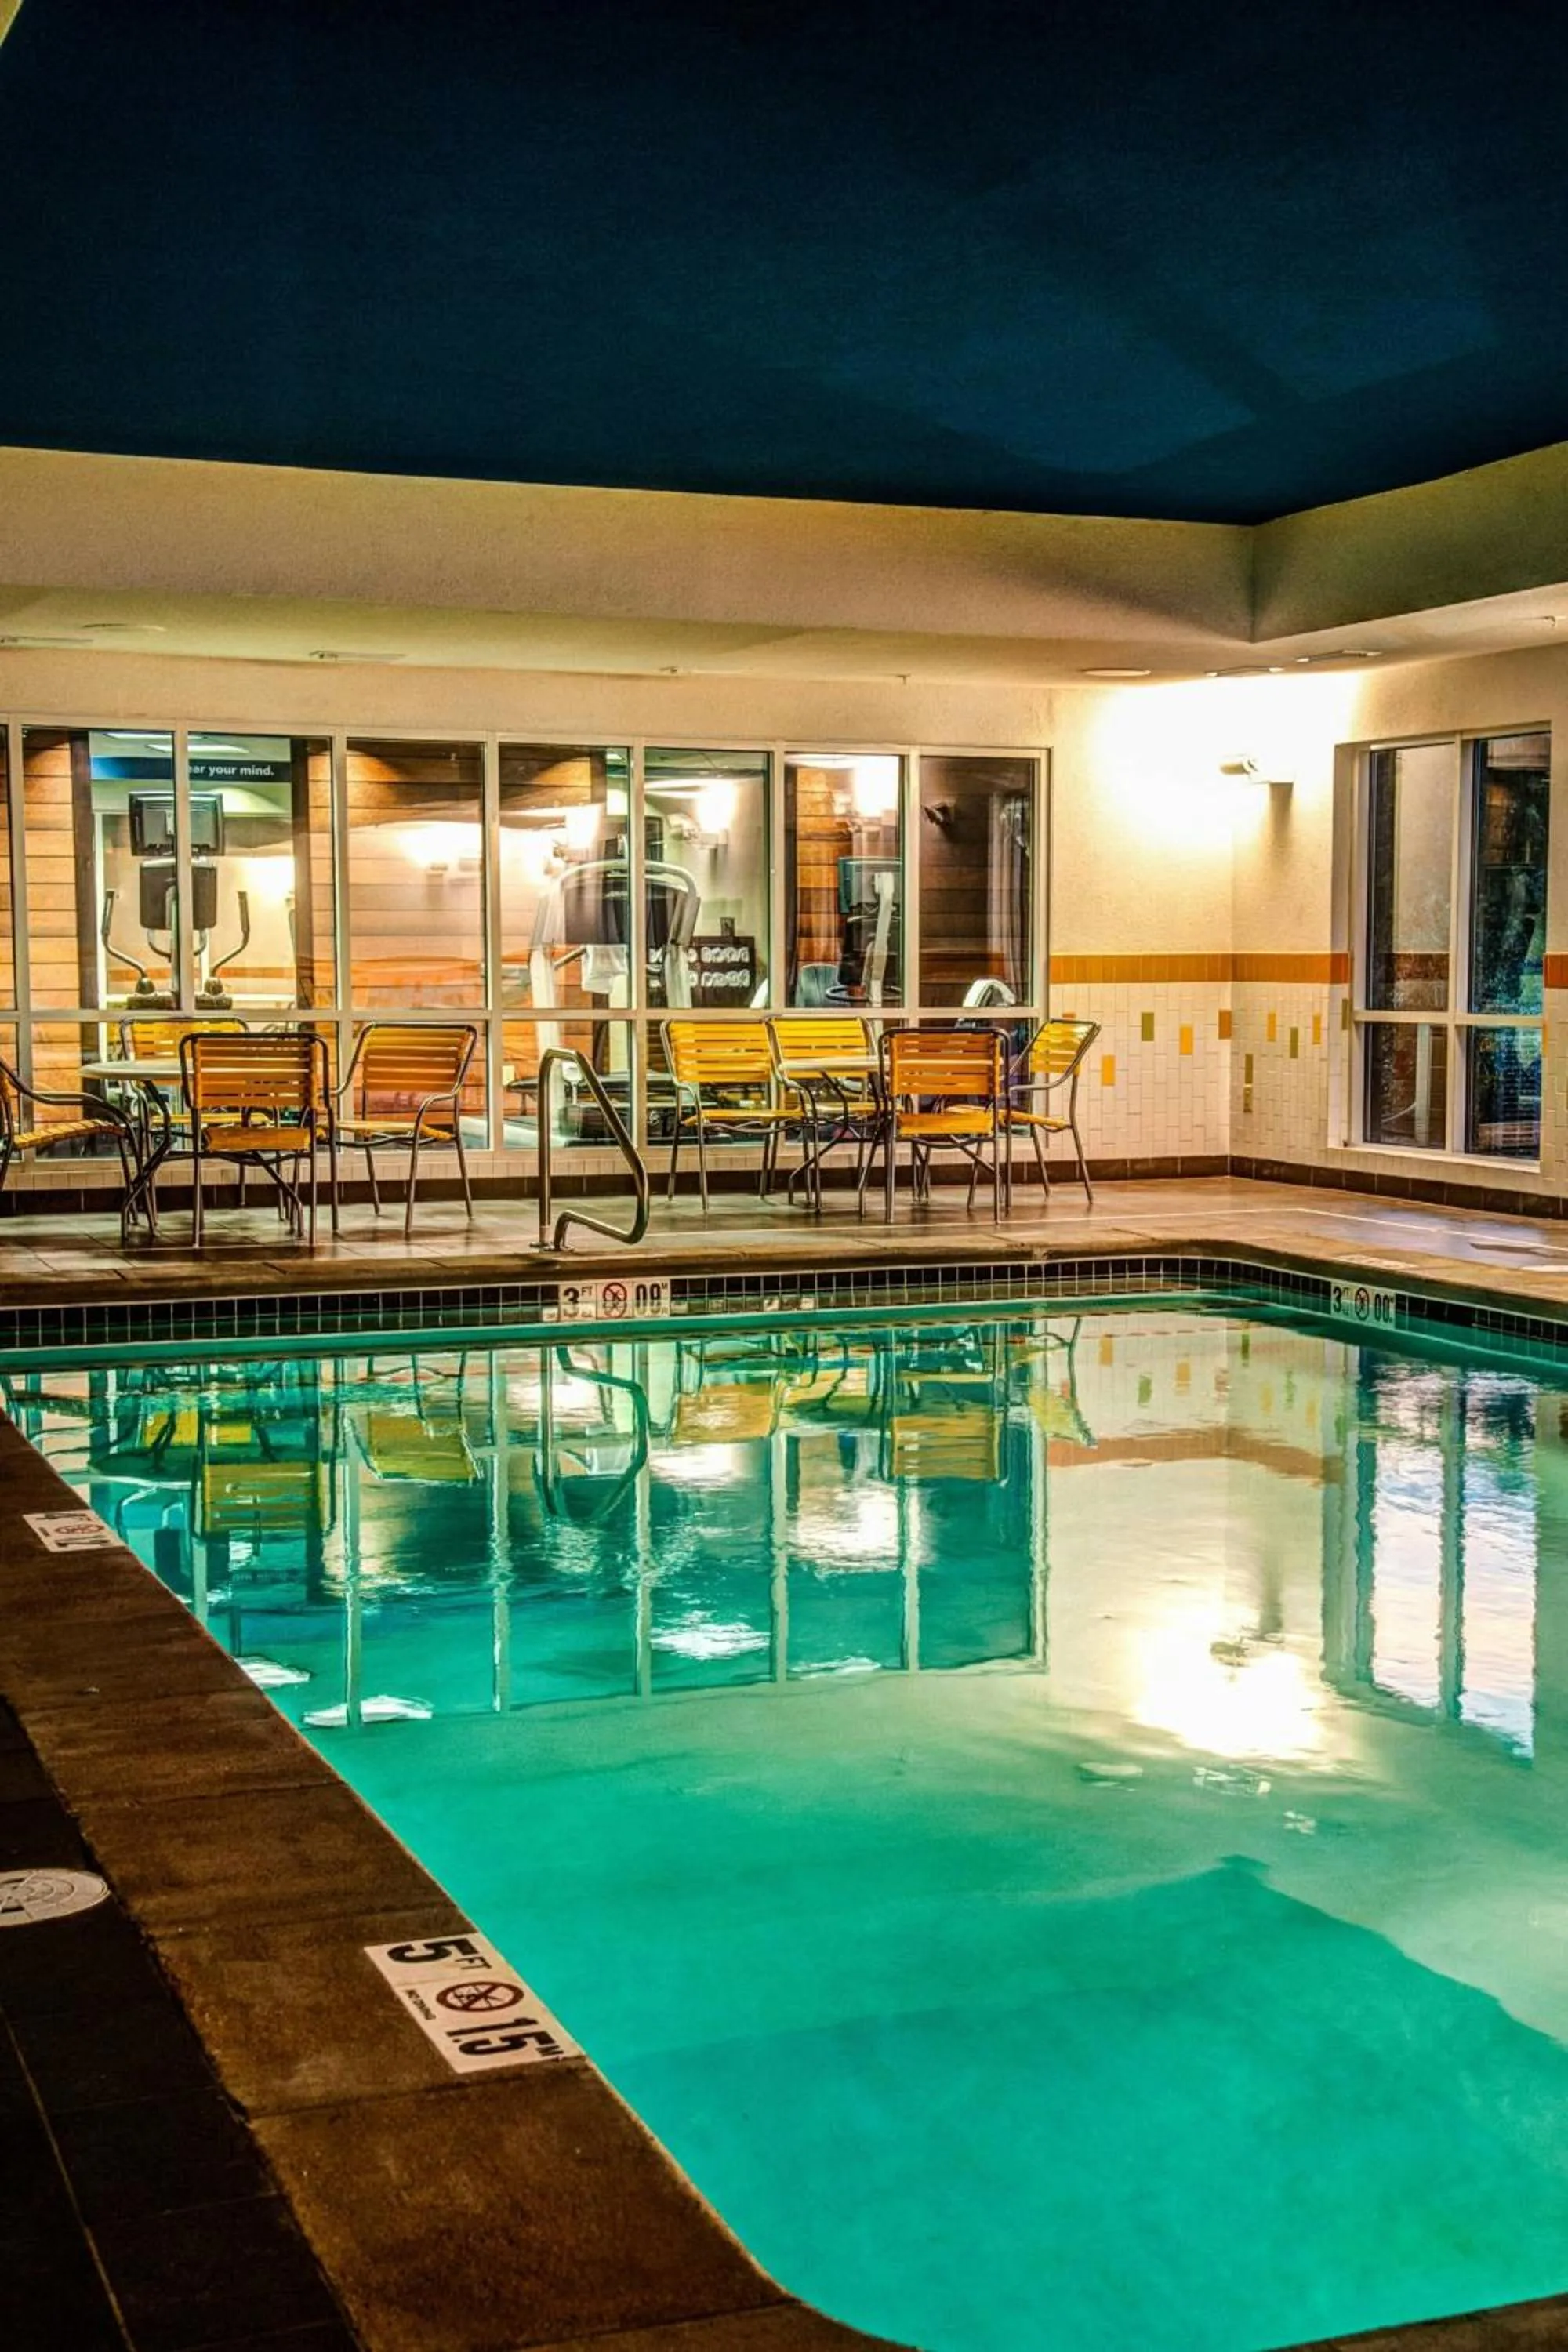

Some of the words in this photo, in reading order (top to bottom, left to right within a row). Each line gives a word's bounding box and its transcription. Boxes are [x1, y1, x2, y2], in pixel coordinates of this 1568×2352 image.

[208, 766, 236, 777] your
[239, 765, 274, 776] mind.
[581, 1287, 593, 1296] FT
[387, 1937, 480, 1964] 5
[455, 1955, 492, 1970] FT
[535, 2045, 564, 2057] M
